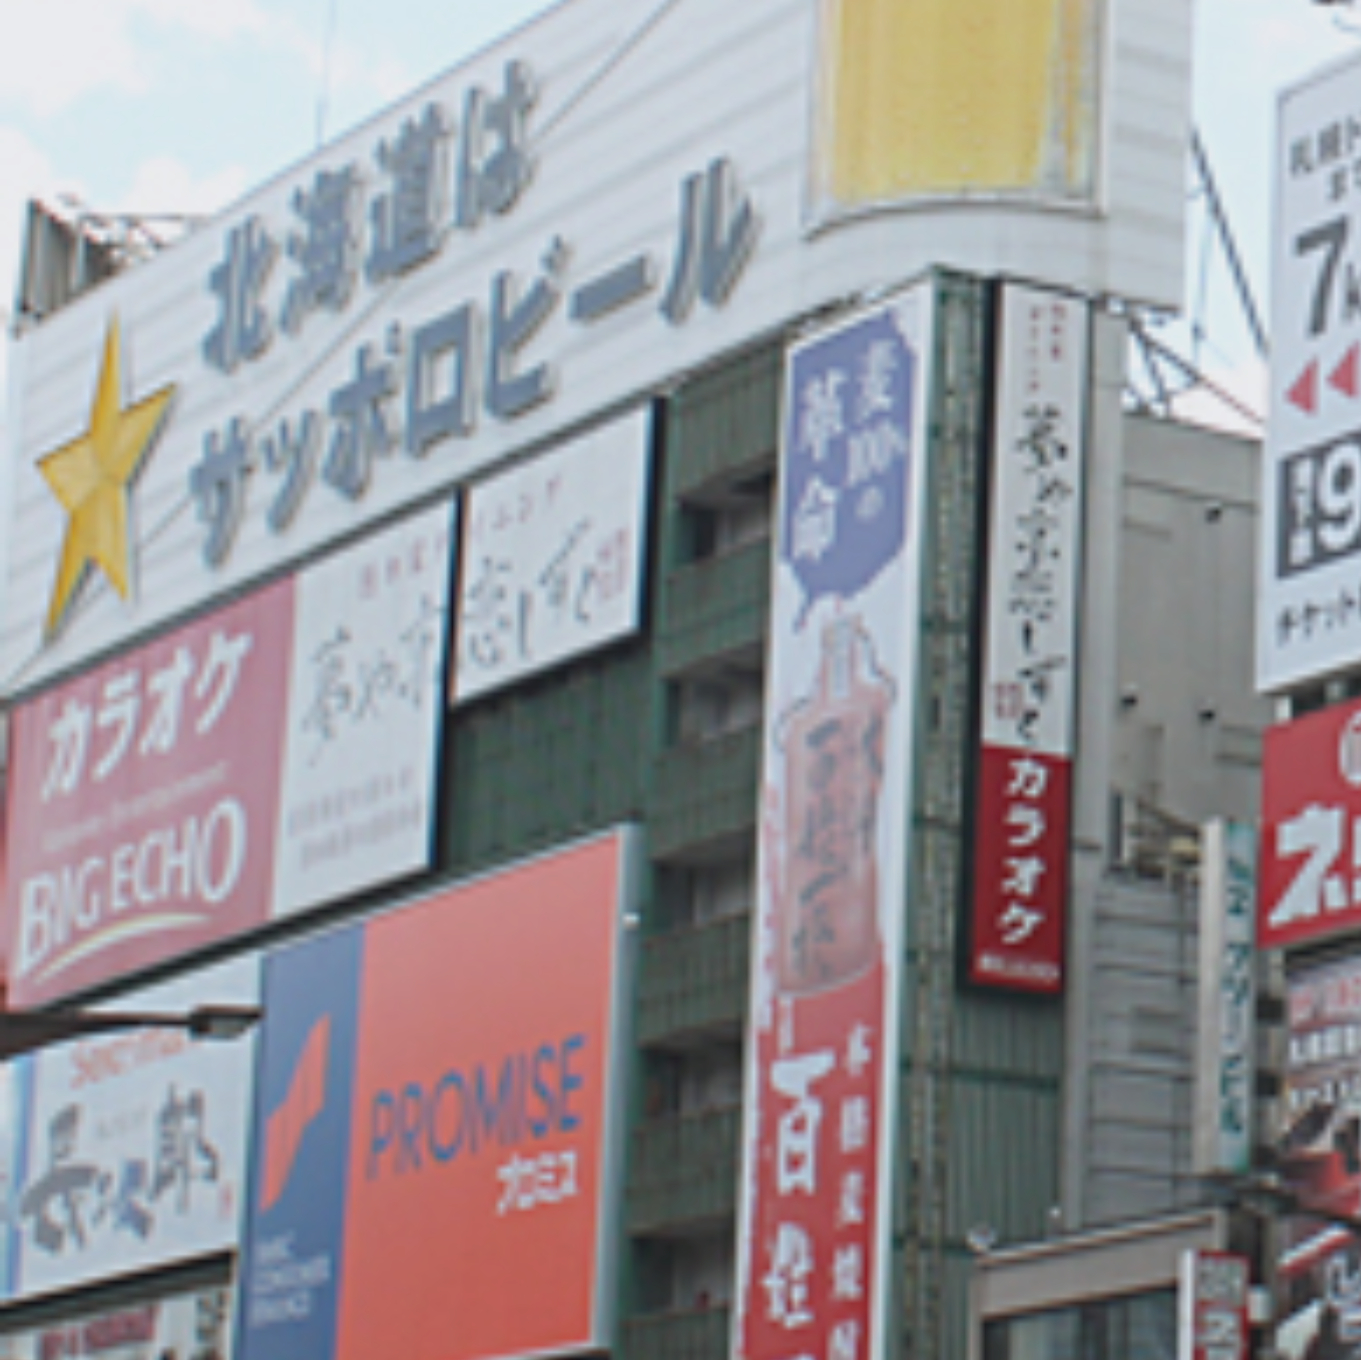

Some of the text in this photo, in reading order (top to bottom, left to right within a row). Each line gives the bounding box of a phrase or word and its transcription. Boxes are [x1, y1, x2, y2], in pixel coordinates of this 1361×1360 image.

[200, 59, 541, 374] 北海道は
[190, 157, 764, 568] サッポロビール
[41, 629, 252, 801] カラオケ
[15, 855, 104, 977] BIG
[111, 795, 247, 915] ECHO
[996, 756, 1050, 945] カラオケ
[366, 1034, 588, 1182] PROMISE
